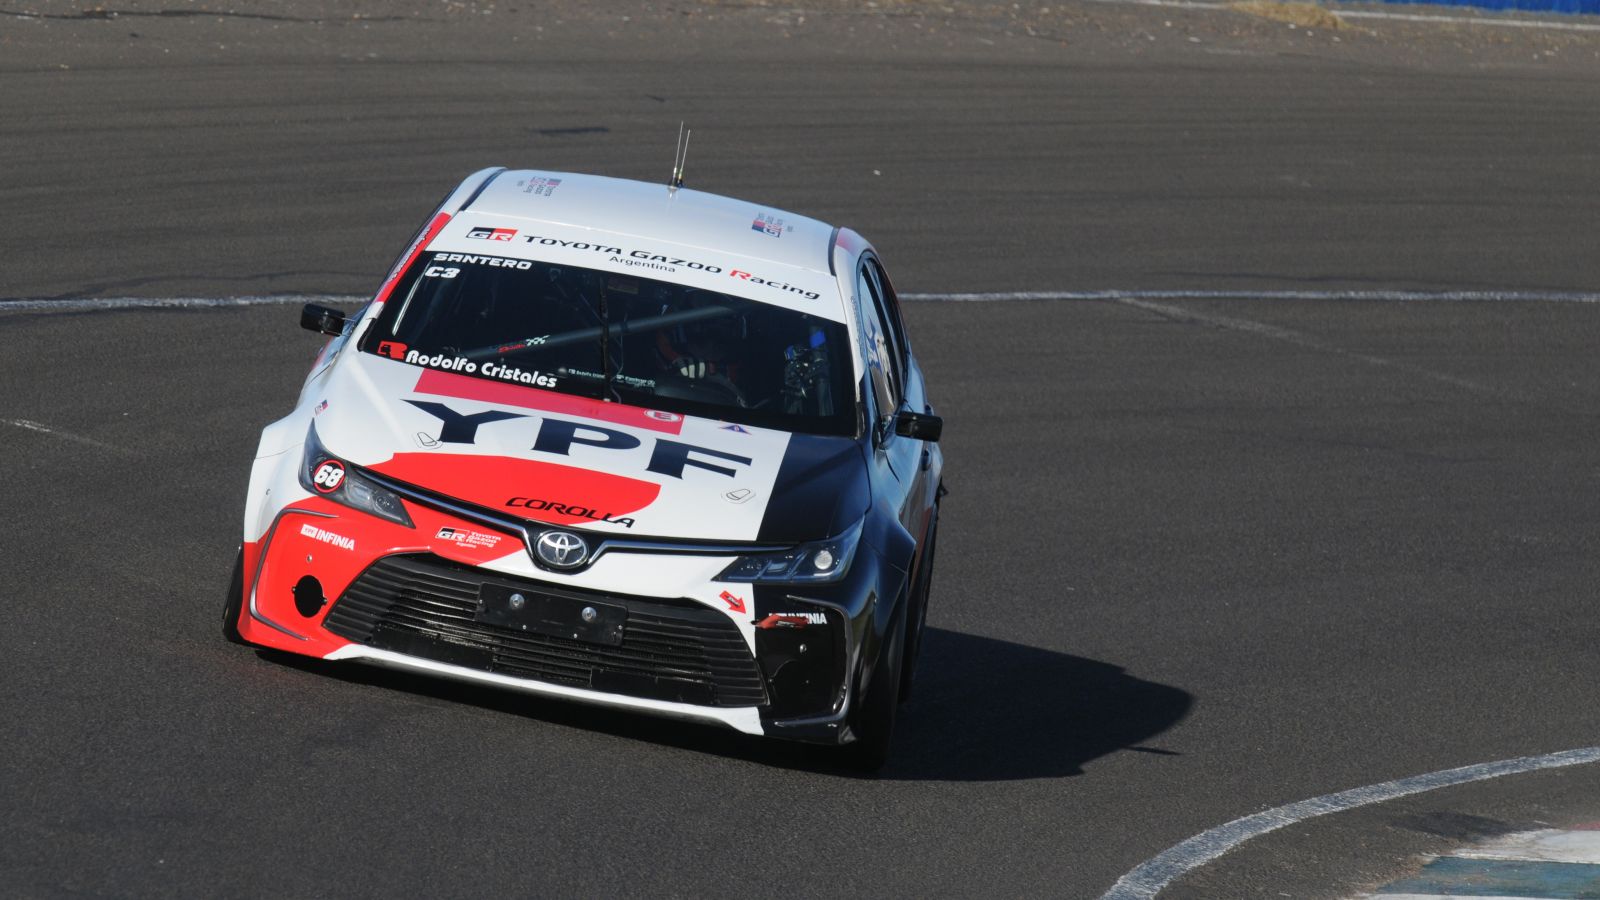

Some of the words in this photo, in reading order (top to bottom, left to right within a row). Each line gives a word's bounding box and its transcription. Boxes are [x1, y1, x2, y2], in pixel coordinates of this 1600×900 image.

[467, 230, 513, 242] GR
[433, 252, 533, 270] SANTERO
[523, 235, 622, 255] TOYOTA
[630, 250, 723, 274] GAZOO
[729, 269, 821, 300] Racing
[609, 255, 676, 273] Argentina
[424, 266, 461, 279] C3
[405, 349, 478, 373] Rodolfo
[481, 361, 558, 388] Cristales
[400, 398, 753, 480] YPF
[313, 464, 345, 488] 68
[505, 496, 636, 529] COROLLA
[316, 529, 355, 551] INFINIA
[437, 531, 466, 542] GR
